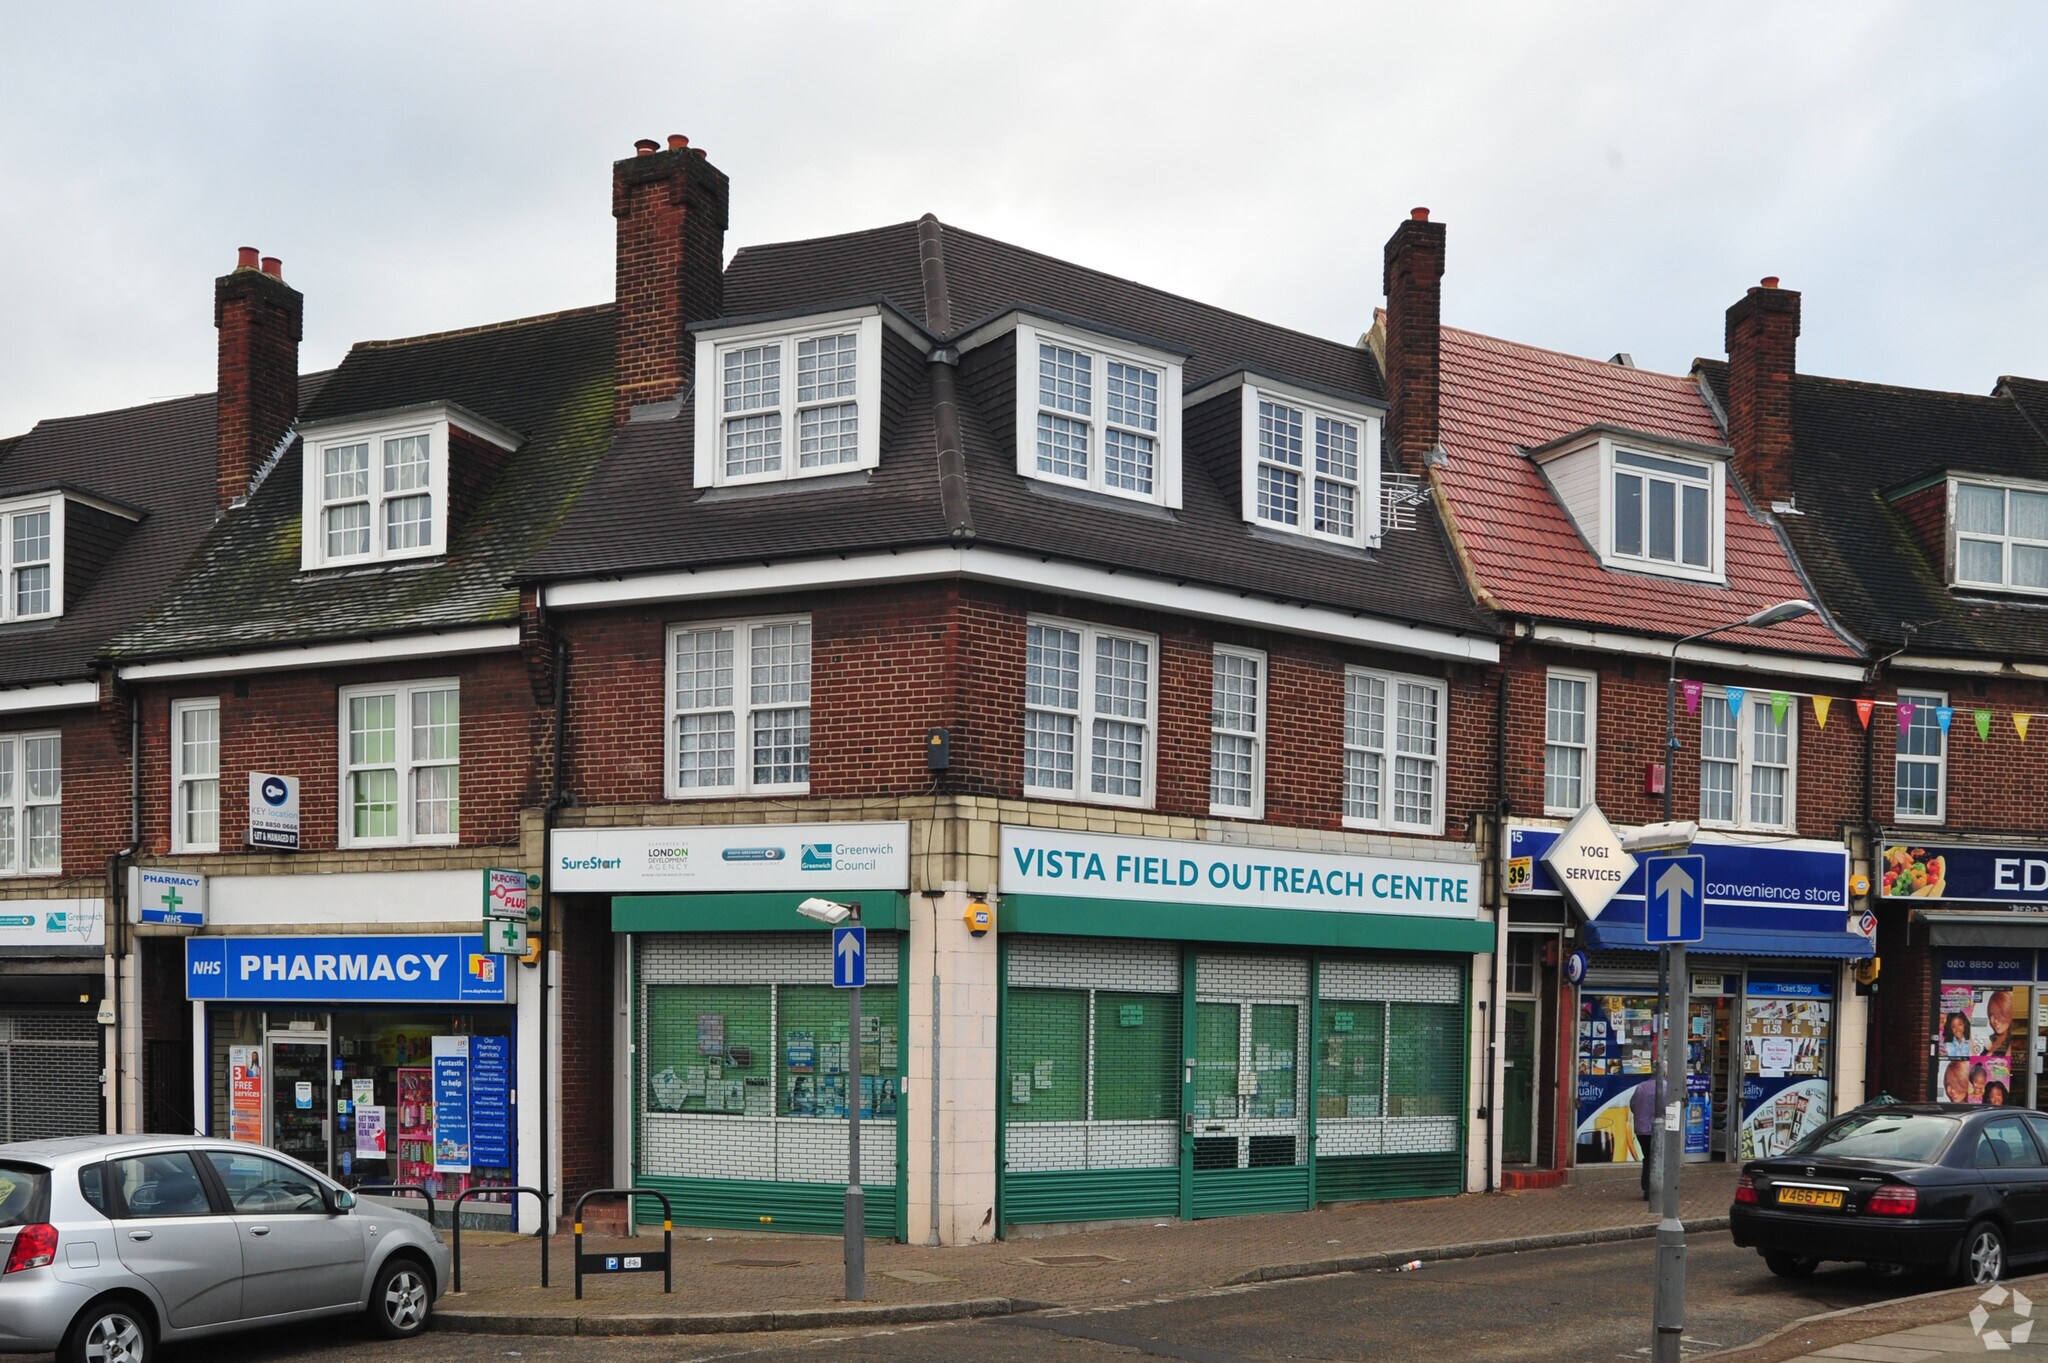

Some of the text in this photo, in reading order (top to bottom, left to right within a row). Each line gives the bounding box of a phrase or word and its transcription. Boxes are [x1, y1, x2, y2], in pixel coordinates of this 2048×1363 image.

[252, 806, 298, 819] KEY location
[1511, 832, 1523, 842] 15
[648, 848, 689, 857] LONDON
[835, 843, 893, 855] Greenwich
[1580, 846, 1609, 859] YOGI
[562, 856, 622, 869] SureStart
[835, 859, 876, 870] Council
[144, 874, 200, 886] PHARMACY
[491, 874, 521, 884] NUROFEN
[1013, 847, 1468, 903] VISTA FIELD OUTREACH CENTRE
[1566, 868, 1622, 882] SERVICES
[1706, 883, 1840, 902] convenience store
[504, 896, 526, 908] PLUS
[67, 912, 103, 921] Greenwich
[164, 914, 182, 923] NHS
[193, 961, 221, 975] NHS
[240, 954, 448, 981] PHARMACY
[1946, 960, 1965, 968] 020
[1998, 961, 2019, 969] 2001
[1776, 984, 1796, 992] Ticket
[1797, 985, 1812, 994] Stop
[1763, 1025, 1781, 1034] £1.50
[1813, 1027, 1821, 1035] £9
[477, 1044, 501, 1052] Pharmacy
[234, 1067, 242, 1080] 3
[235, 1082, 252, 1090] FREE
[448, 1080, 462, 1088] help
[1781, 1188, 1840, 1204] V466 FLH
